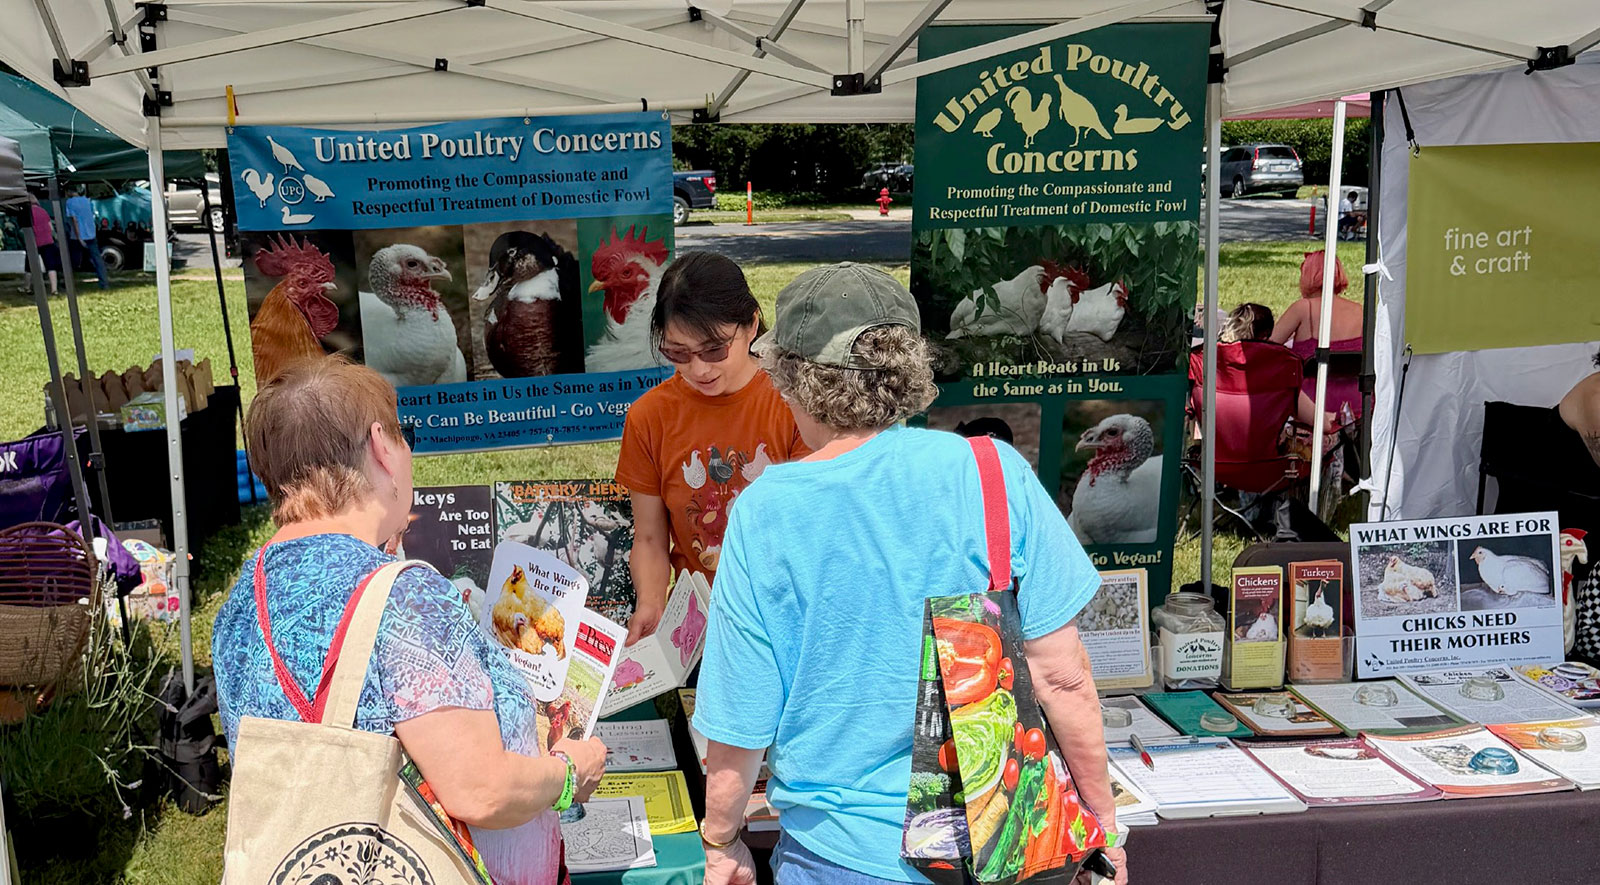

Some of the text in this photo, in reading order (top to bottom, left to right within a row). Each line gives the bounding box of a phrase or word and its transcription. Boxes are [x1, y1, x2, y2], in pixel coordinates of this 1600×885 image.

[933, 44, 1192, 133] United Poultry
[312, 128, 662, 163] United Poultry Concerns
[986, 142, 1138, 174] Concerns
[367, 166, 628, 193] Promoting the Compassionate and
[281, 186, 302, 196] UPC
[947, 180, 1172, 201] Promoting the Compassionate and
[352, 187, 650, 217] Respectful Treatment of Domestic Fowl
[929, 200, 1187, 222] Respectful Treatment of Domestic Fowl
[1444, 226, 1533, 250] fine art
[1450, 251, 1532, 276] & craft
[973, 358, 1121, 377] A Heart Beats in Us
[437, 391, 478, 405] Beats
[483, 388, 497, 401] in
[503, 386, 522, 399] Us
[526, 384, 549, 398] the
[553, 381, 594, 396] Same
[599, 382, 614, 392] as
[618, 378, 632, 391] in
[973, 378, 1124, 397] the Same as in You.
[399, 415, 422, 428] ife
[427, 414, 459, 428] Can
[464, 411, 484, 426] Be
[488, 404, 557, 424] Beautiful
[571, 403, 593, 417] Go
[597, 401, 632, 416] Vega
[484, 432, 496, 440] VA
[498, 430, 520, 439] 23405
[414, 491, 455, 509] keys
[438, 509, 489, 522] Are Too
[458, 524, 491, 536] Neat
[1358, 519, 1551, 544] WHAT WINGS ARE FOR
[451, 538, 492, 551] To Eat
[1090, 551, 1162, 567] Go Vegan!
[528, 562, 581, 591] What Wings
[1237, 577, 1279, 587] Chickens
[1301, 568, 1335, 578] Turkeys
[534, 579, 567, 599] Are For
[1402, 612, 1517, 632] CHICKS NEED
[1177, 638, 1221, 653] United Poultry
[1390, 631, 1531, 653] THEIR MOTHERS
[514, 652, 542, 672] Vegan!
[1176, 664, 1219, 672] DONATIONS
